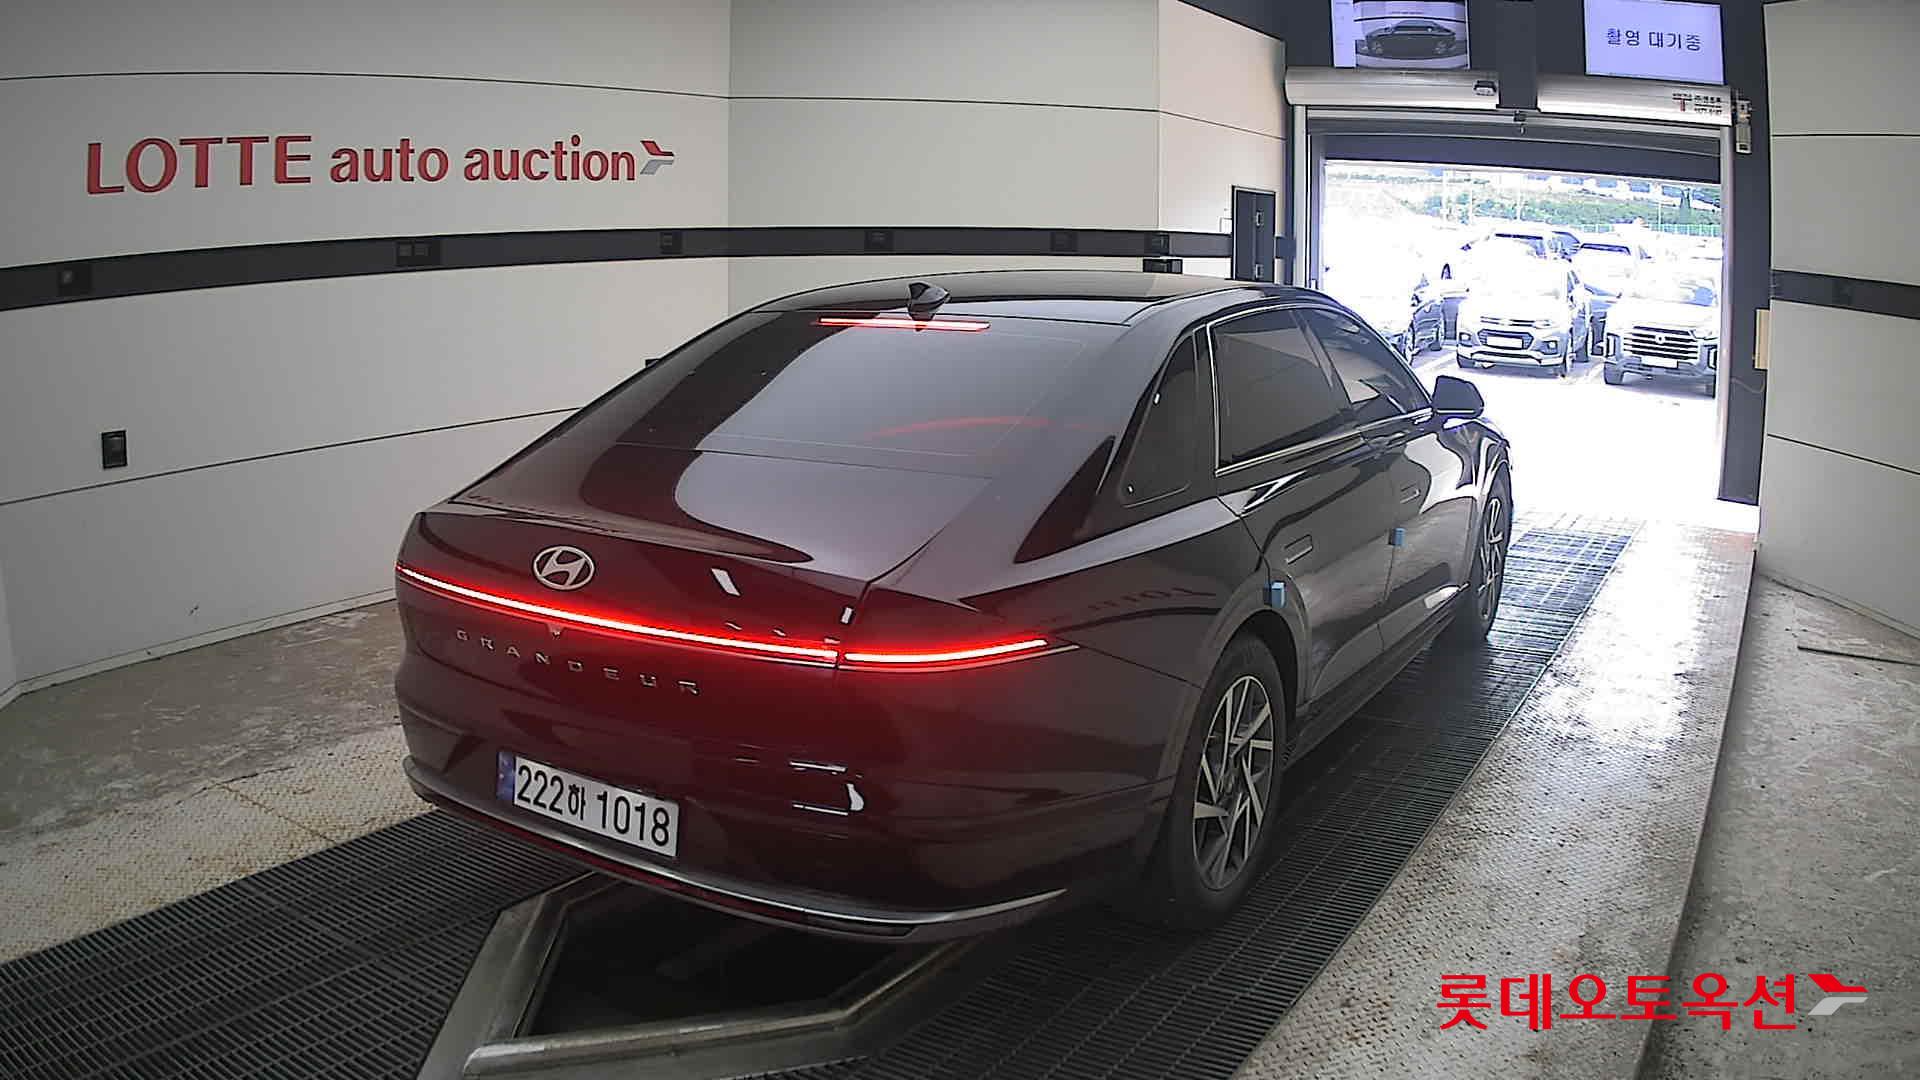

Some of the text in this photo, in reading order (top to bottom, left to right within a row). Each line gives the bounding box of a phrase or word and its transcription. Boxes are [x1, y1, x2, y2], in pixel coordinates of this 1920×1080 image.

[1607, 28, 1701, 51] 촬영 대기중
[86, 134, 636, 195] LOTTE auto auction
[456, 629, 700, 695] GRANDEUR
[517, 765, 670, 847] 222하 1018
